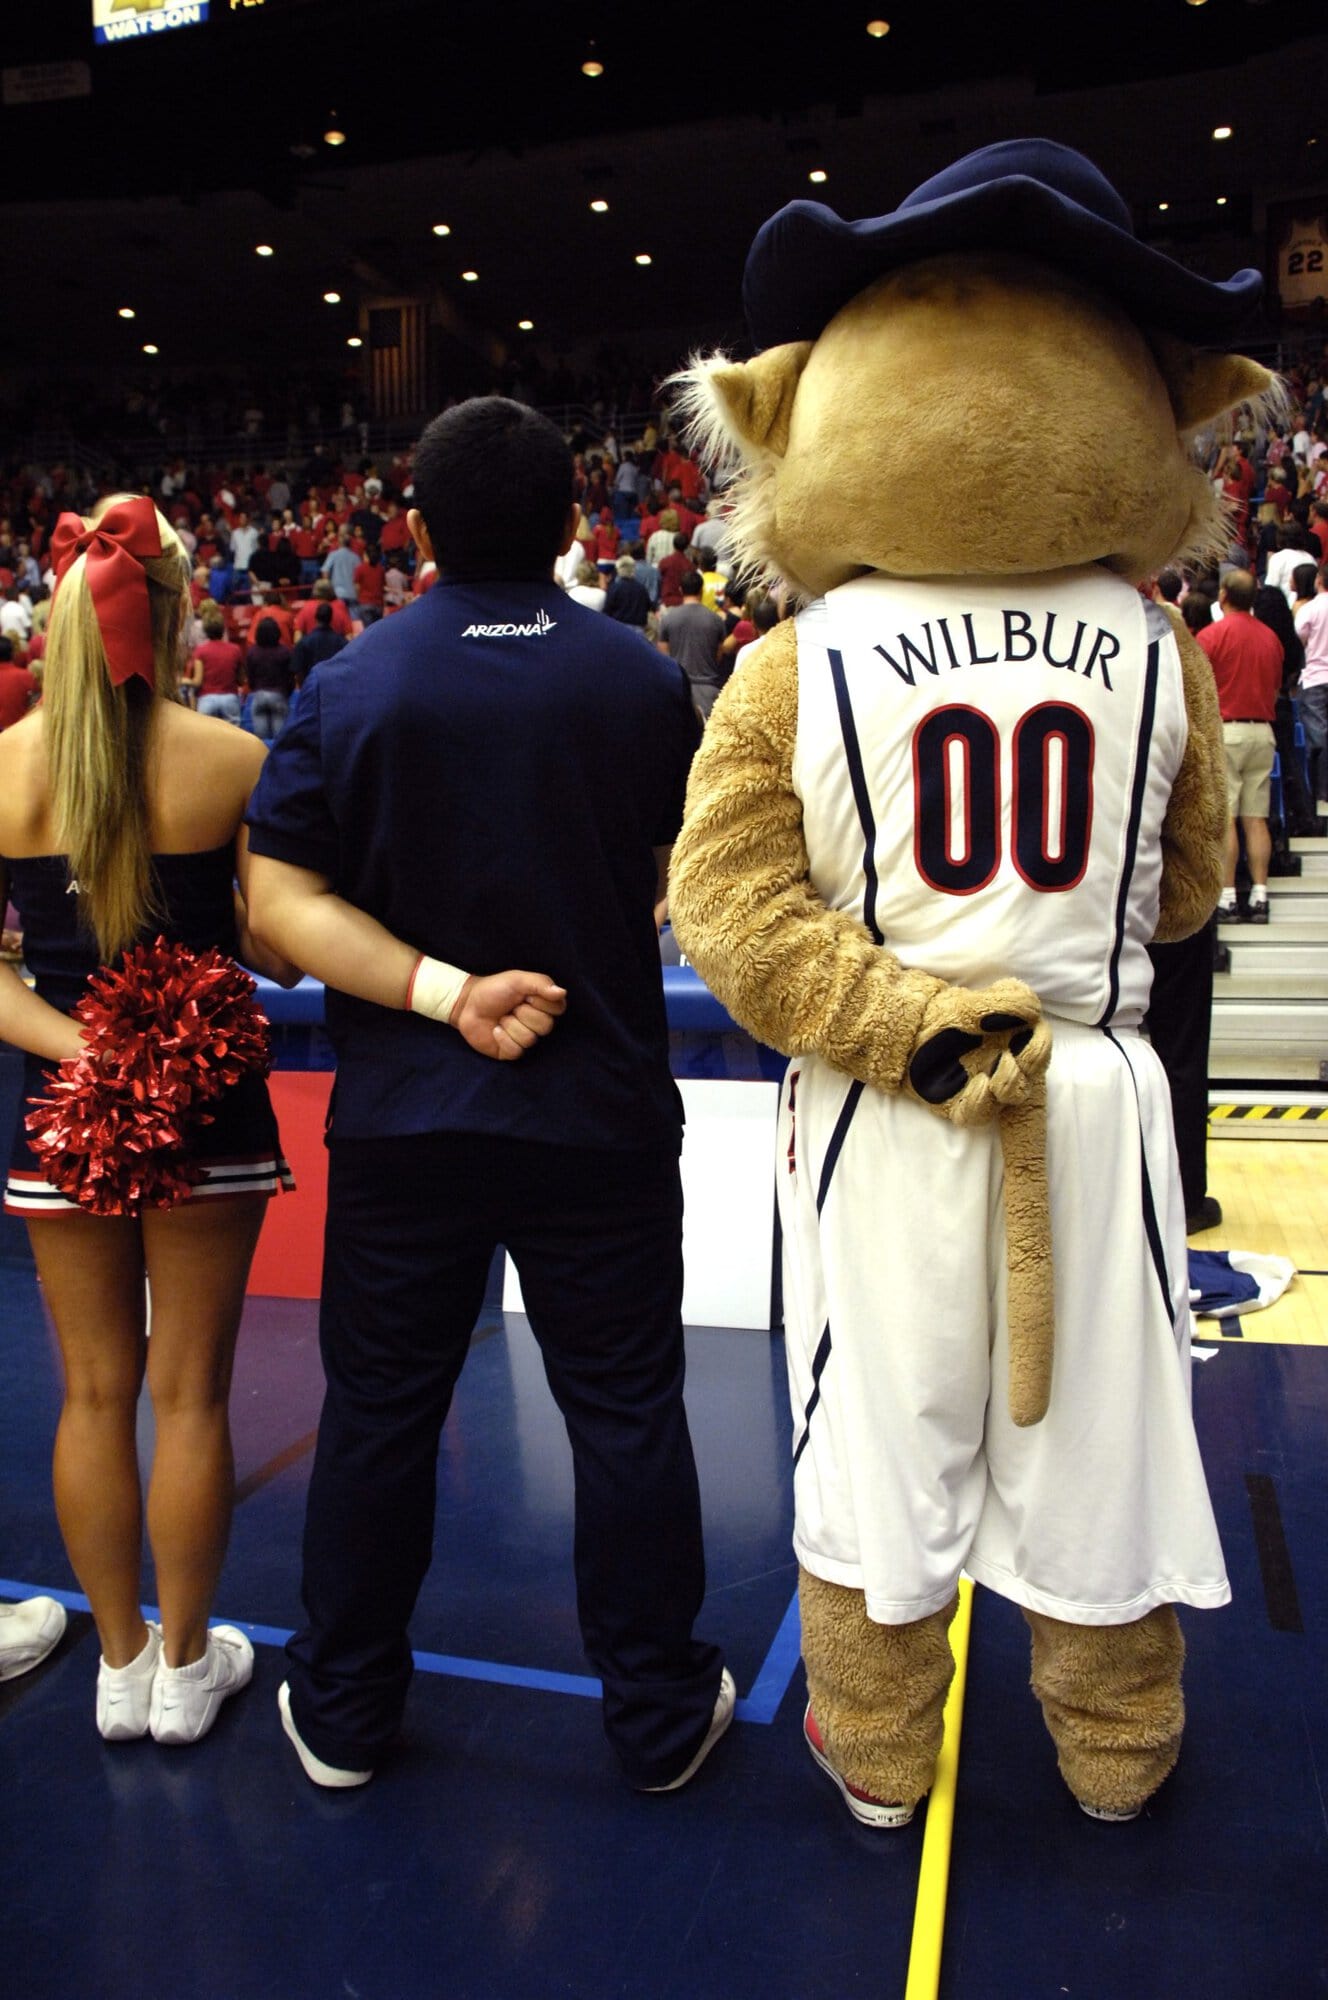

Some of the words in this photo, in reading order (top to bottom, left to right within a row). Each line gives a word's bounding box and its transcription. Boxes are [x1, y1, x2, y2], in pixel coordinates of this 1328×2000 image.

[103, 4, 201, 41] WATSON
[1288, 250, 1324, 276] 22
[872, 609, 1121, 692] WILBUR
[912, 700, 1096, 896] 00
